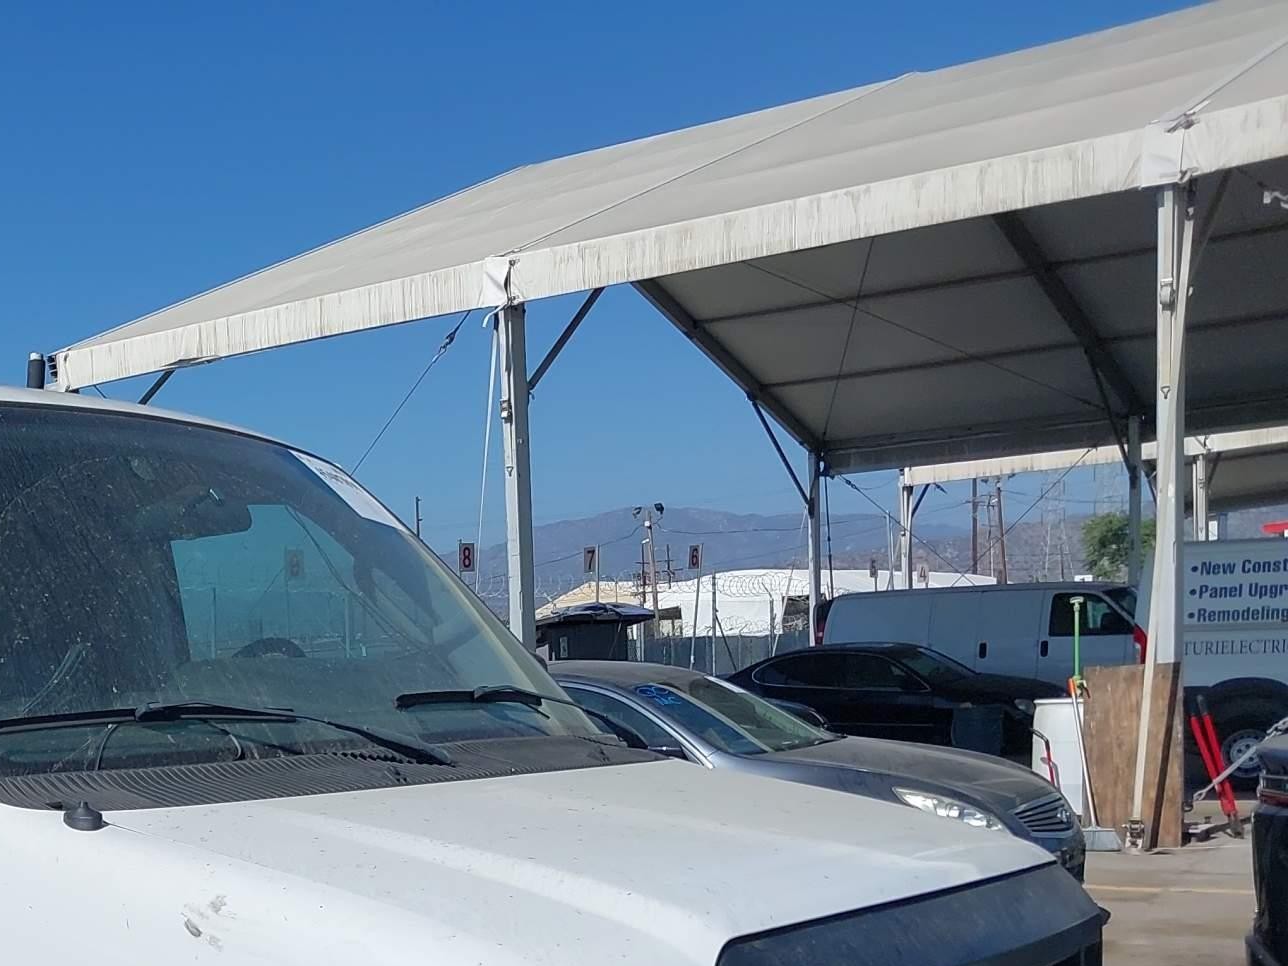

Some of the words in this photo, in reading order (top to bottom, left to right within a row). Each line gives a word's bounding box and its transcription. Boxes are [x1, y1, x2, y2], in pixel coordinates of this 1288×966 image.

[462, 546, 472, 569] 8
[586, 549, 596, 571] 7
[690, 547, 700, 567] 6
[919, 565, 928, 582] 4
[1200, 561, 1236, 576] New
[1241, 559, 1288, 574] Const
[1198, 583, 1243, 599] Panel
[1197, 606, 1288, 623] Remodeling
[1184, 639, 1288, 656] TURIELECTRI
